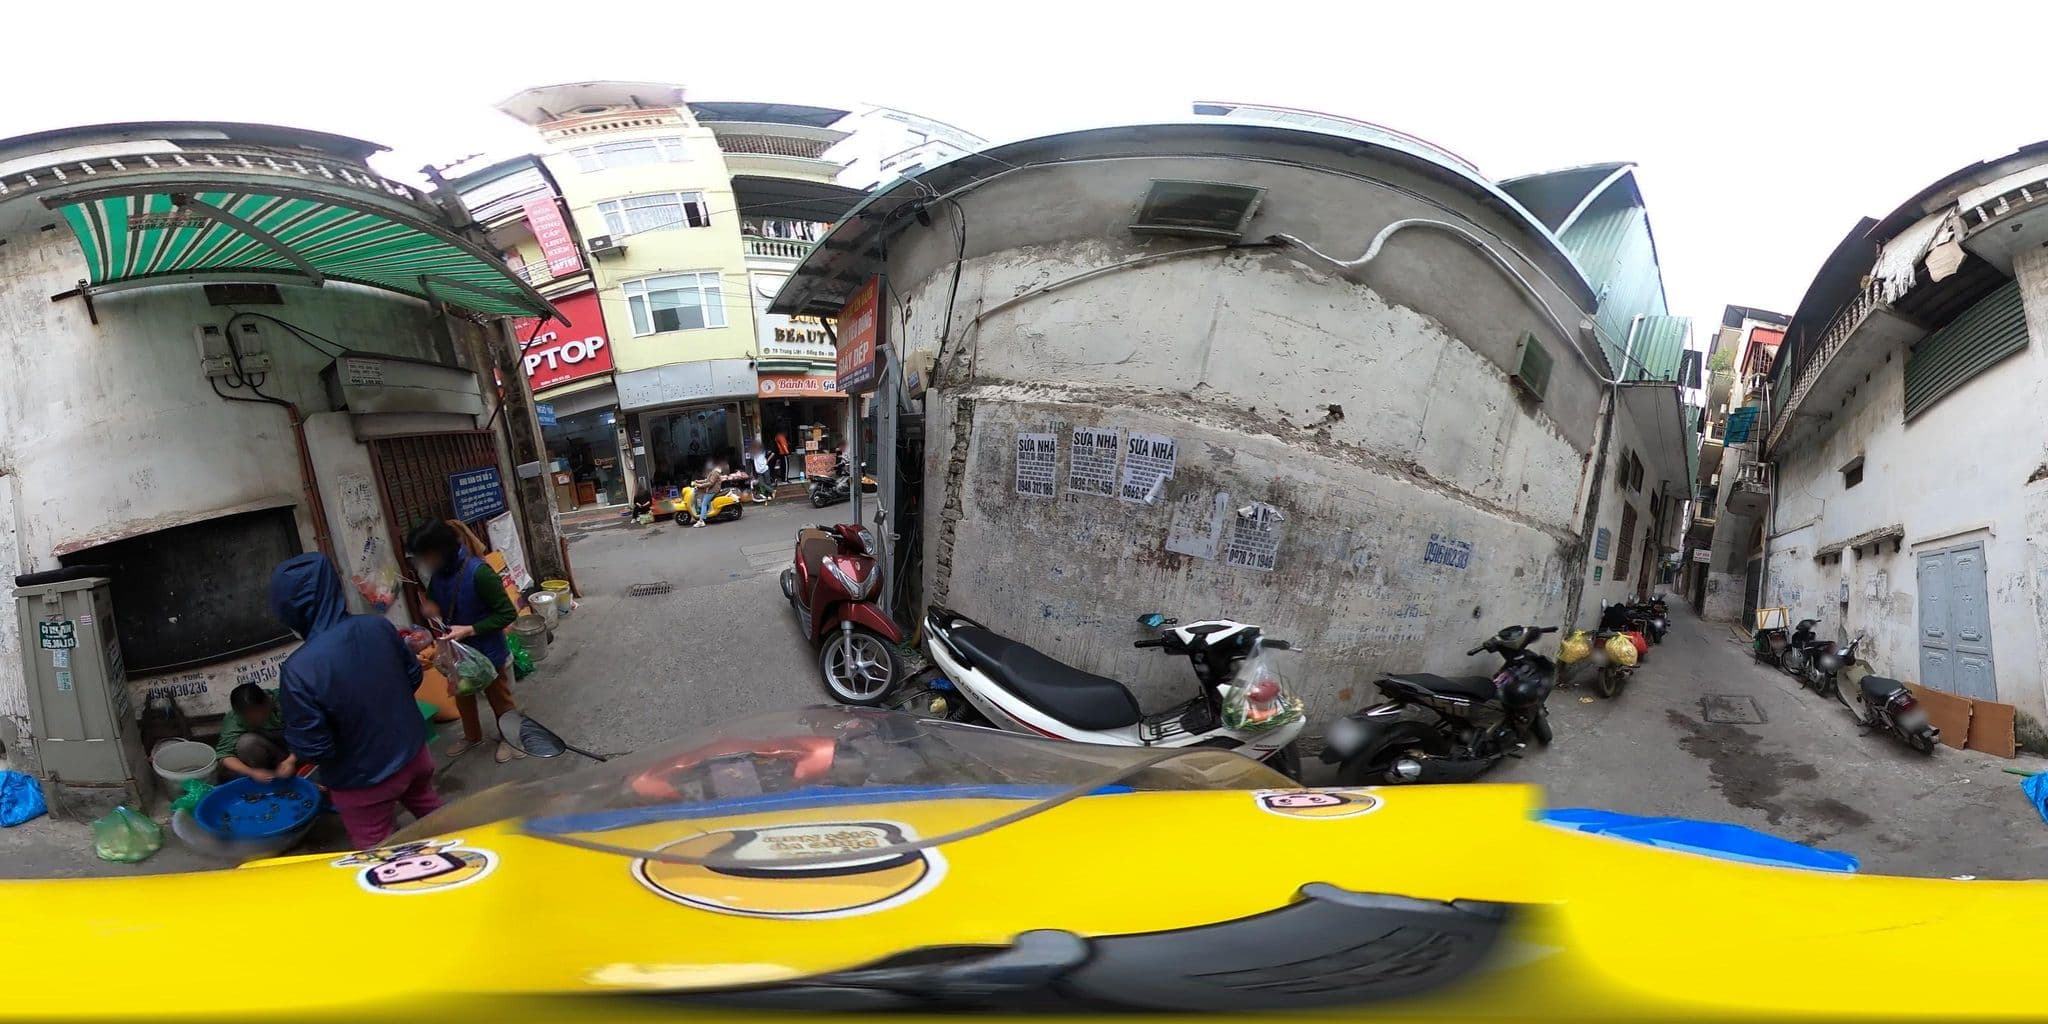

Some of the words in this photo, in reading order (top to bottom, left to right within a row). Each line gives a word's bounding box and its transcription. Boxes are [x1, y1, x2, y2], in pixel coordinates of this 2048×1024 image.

[523, 336, 604, 376] PTOP
[779, 378, 803, 390] Bánh
[1018, 434, 1035, 452] SỬA
[1037, 438, 1056, 453] NHÀ
[1073, 427, 1093, 447] SỬA
[1096, 432, 1118, 450] NHÀ
[1129, 435, 1149, 456] SỬA
[1151, 440, 1175, 461] NHÀ
